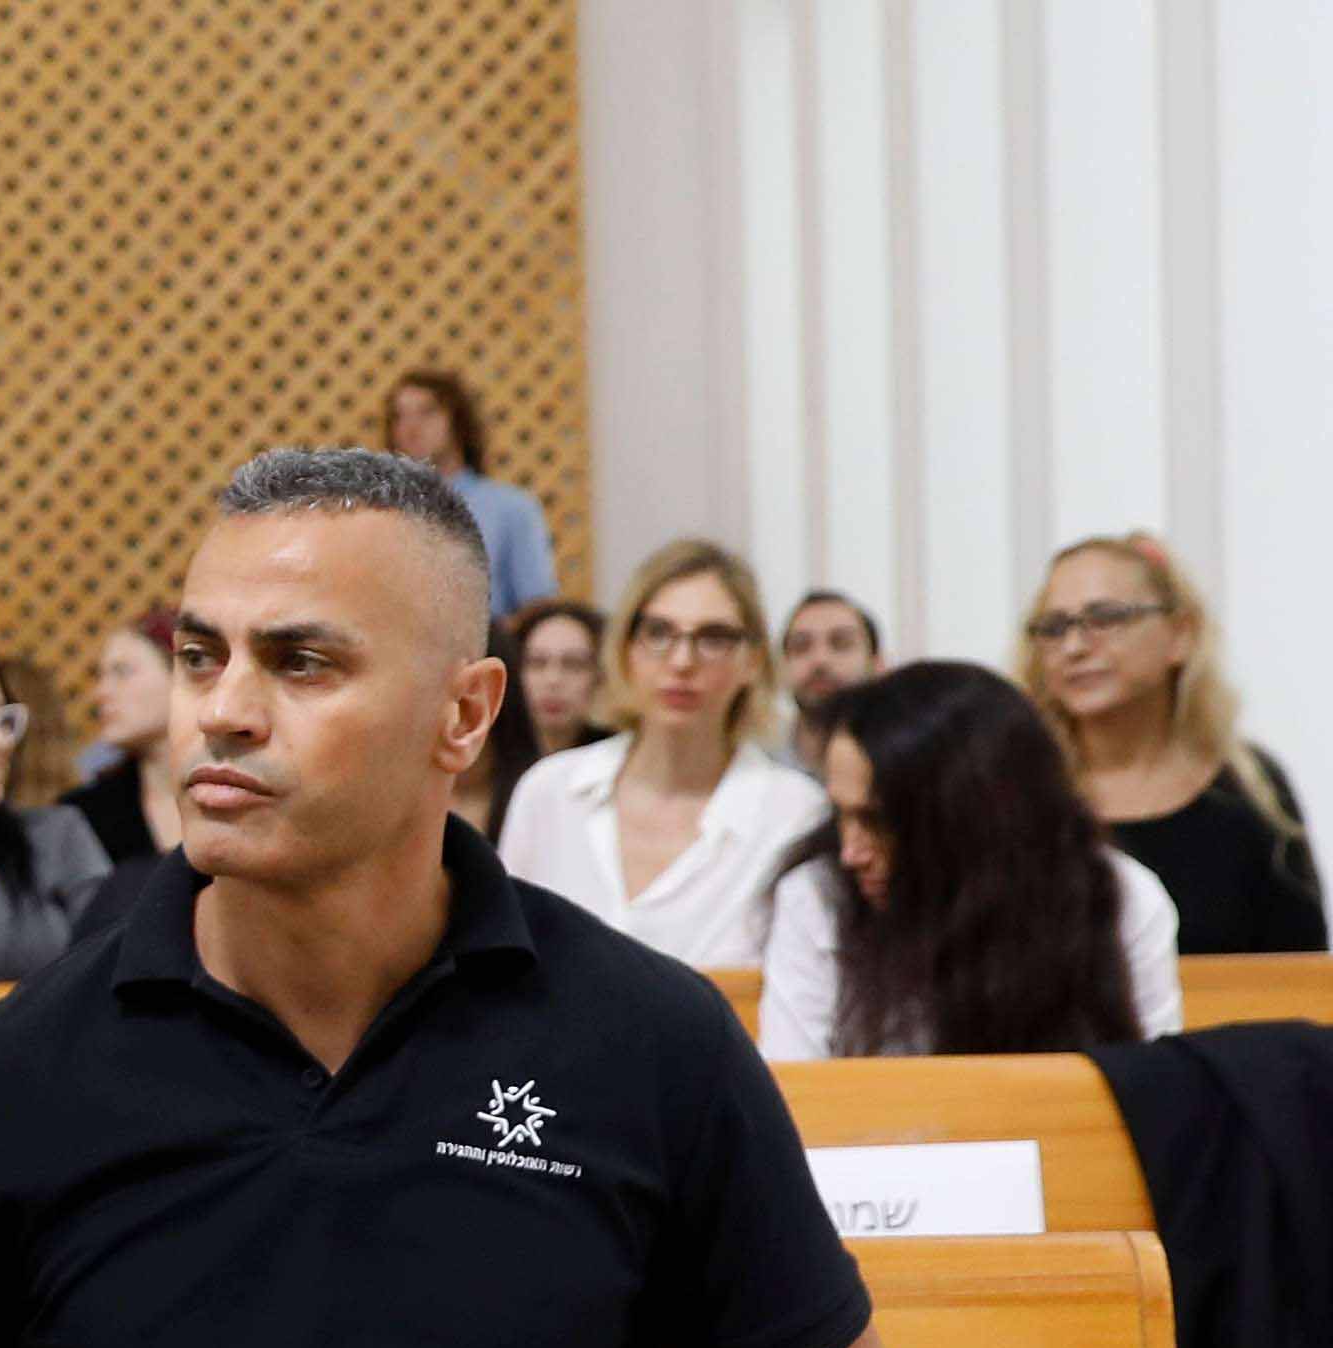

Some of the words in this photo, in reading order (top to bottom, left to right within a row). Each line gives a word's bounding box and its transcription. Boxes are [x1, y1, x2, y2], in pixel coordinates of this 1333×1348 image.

[436, 1141, 486, 1161] וההגירה
[486, 1149, 548, 1171] האוכלוסין
[548, 1160, 582, 1178] רשות
[834, 1198, 918, 1231] שמו
